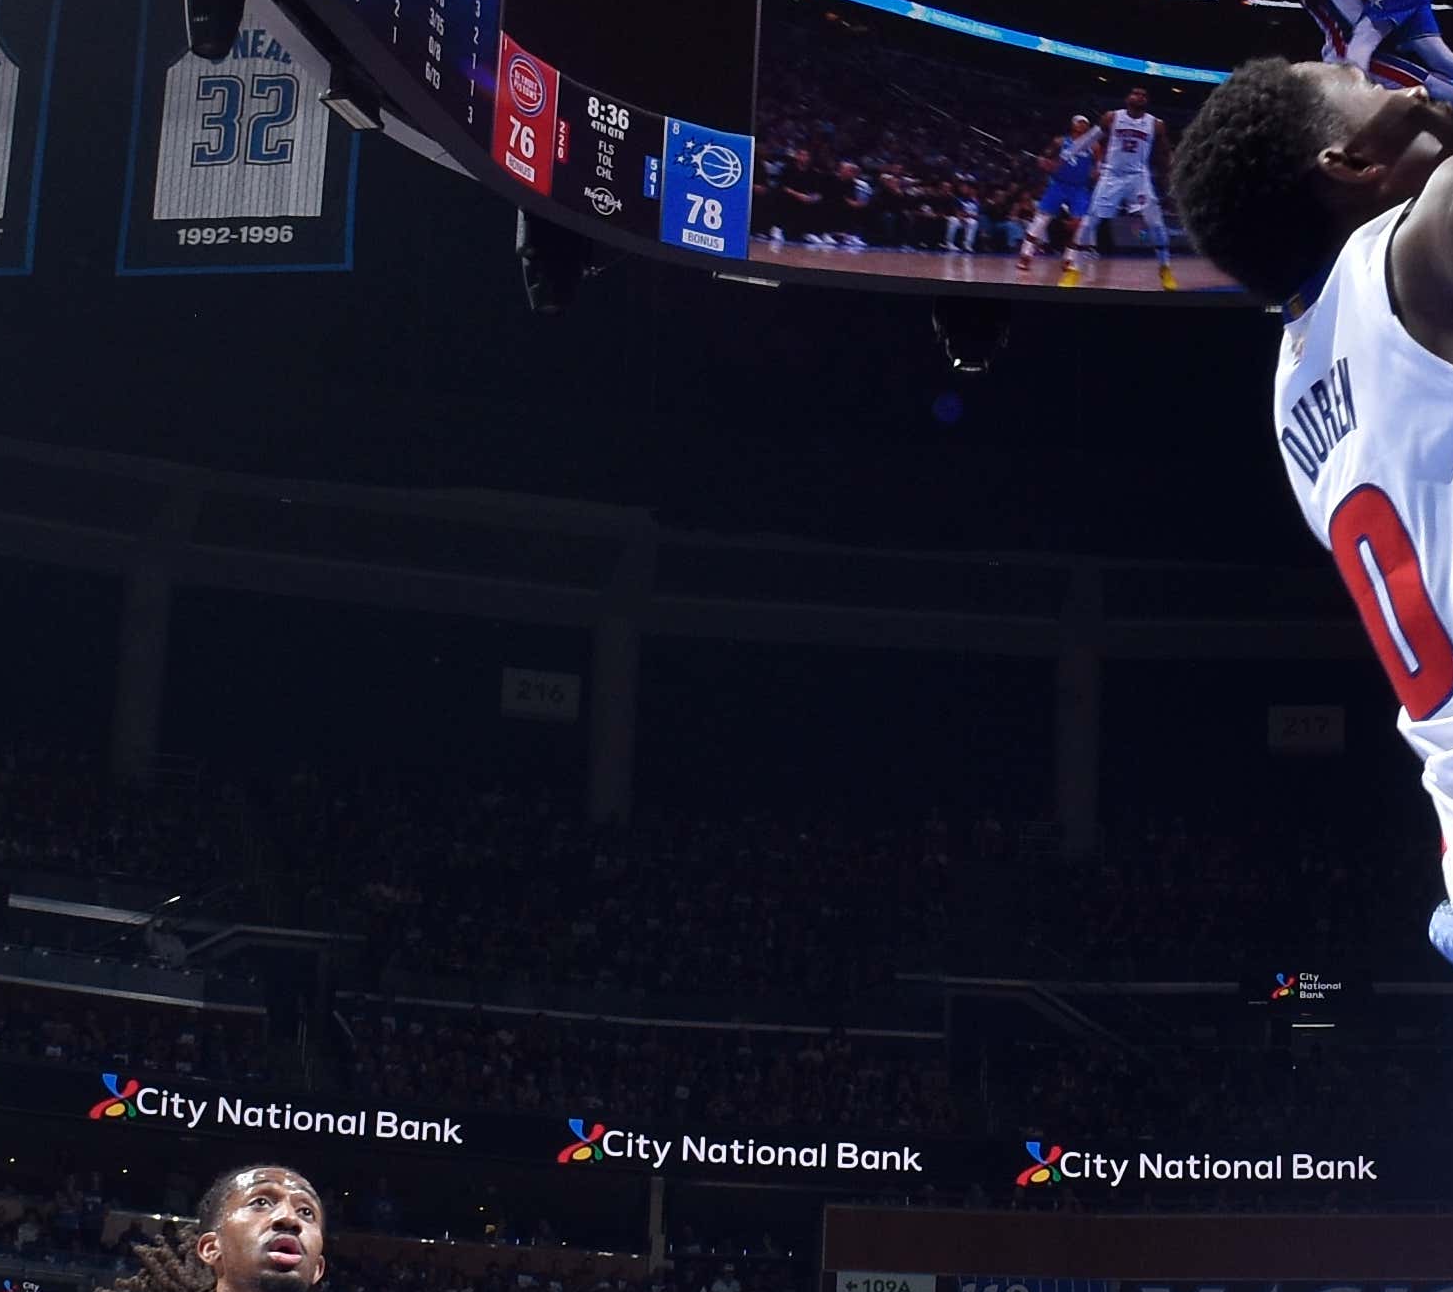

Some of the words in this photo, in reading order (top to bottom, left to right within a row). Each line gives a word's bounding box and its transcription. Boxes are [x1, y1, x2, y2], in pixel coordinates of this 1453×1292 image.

[191, 74, 299, 167] 32
[587, 96, 630, 130] 8:36
[509, 116, 535, 158] 76
[686, 194, 723, 230] 78
[177, 225, 293, 246] 1992-1996
[687, 231, 720, 249] BONUS
[1281, 357, 1357, 482] DUREN
[1300, 973, 1318, 981] City
[1300, 991, 1324, 999] Bank
[137, 1087, 206, 1128] City
[217, 1097, 365, 1137] National
[376, 1112, 463, 1144] Bank
[602, 1129, 673, 1169] City
[681, 1136, 827, 1167] National
[836, 1142, 922, 1172] Bank
[1059, 1152, 1129, 1186] City
[1138, 1153, 1283, 1180] National
[1292, 1154, 1377, 1180] Bank
